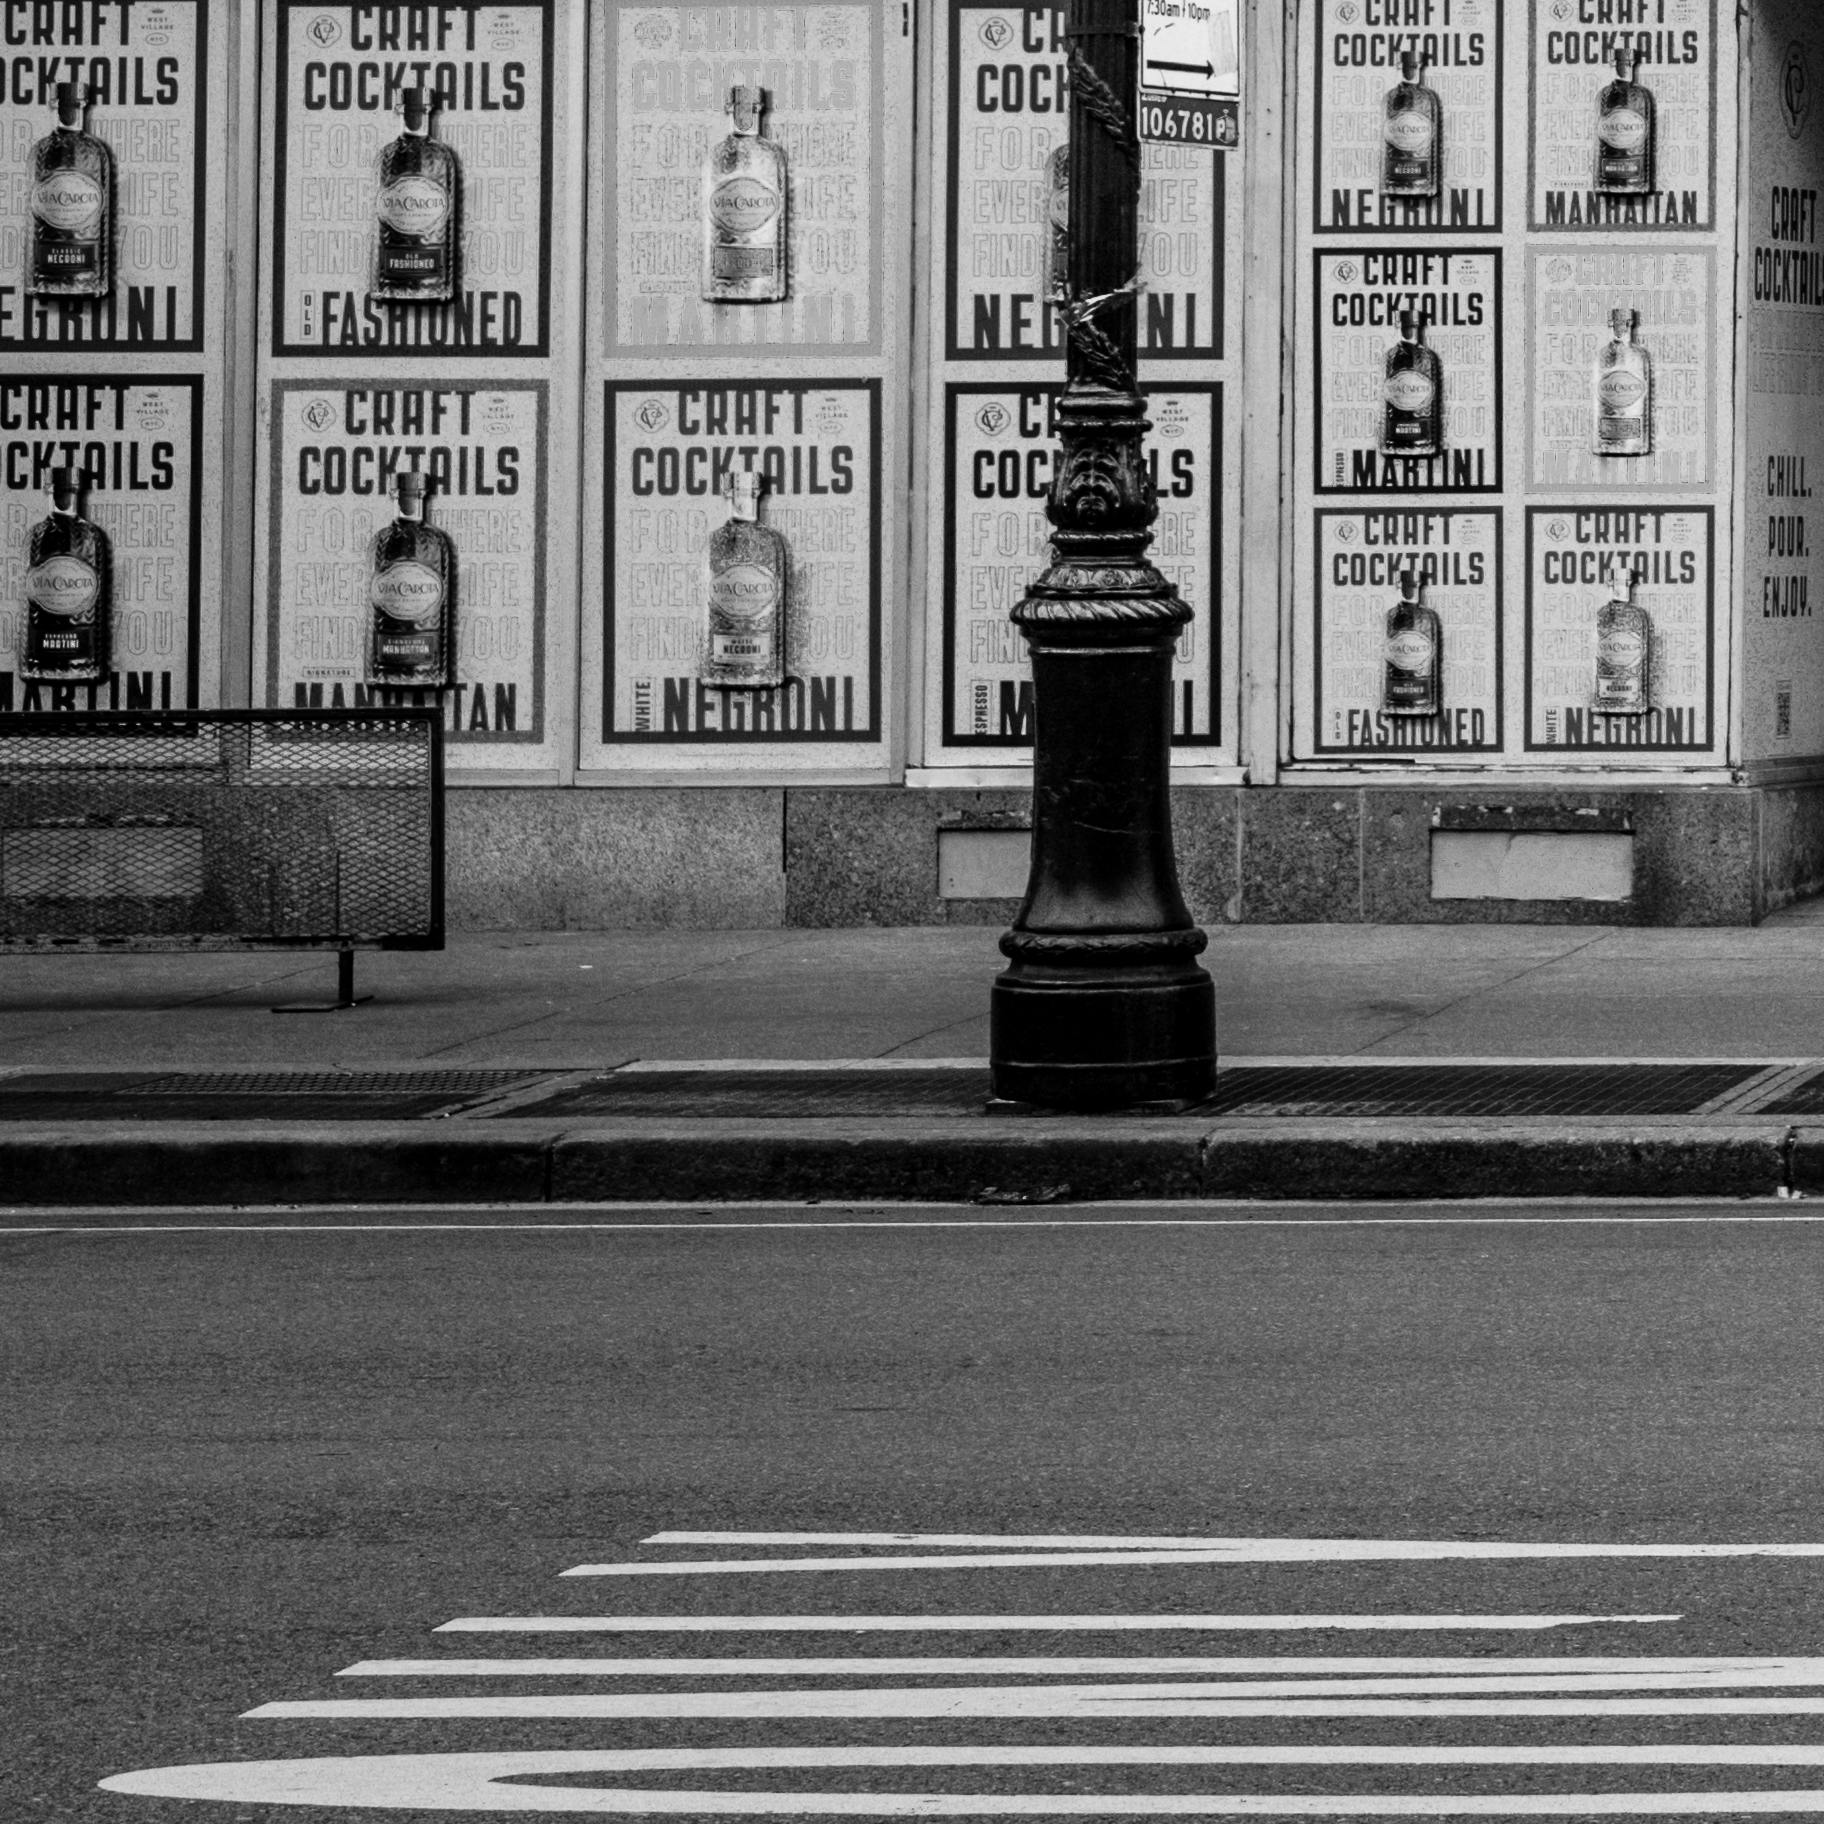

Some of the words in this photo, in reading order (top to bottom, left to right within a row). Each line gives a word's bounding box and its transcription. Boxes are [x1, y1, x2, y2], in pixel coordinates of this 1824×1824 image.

[351, 5, 481, 51] CRAFT
[1188, 3, 1210, 22] 10pm
[1335, 31, 1484, 67] COCKTAILS
[303, 63, 525, 110] COCKTAILS
[1771, 186, 1817, 244] CRAFT
[302, 293, 313, 338] OLD
[678, 388, 808, 437] CRAFT
[632, 447, 853, 496] COCKTAILS
[1767, 455, 1811, 497] CHILL.
[1768, 514, 1808, 557] POUR.
[1762, 576, 1811, 618] ENJOY.
[636, 681, 651, 732] WHITE
